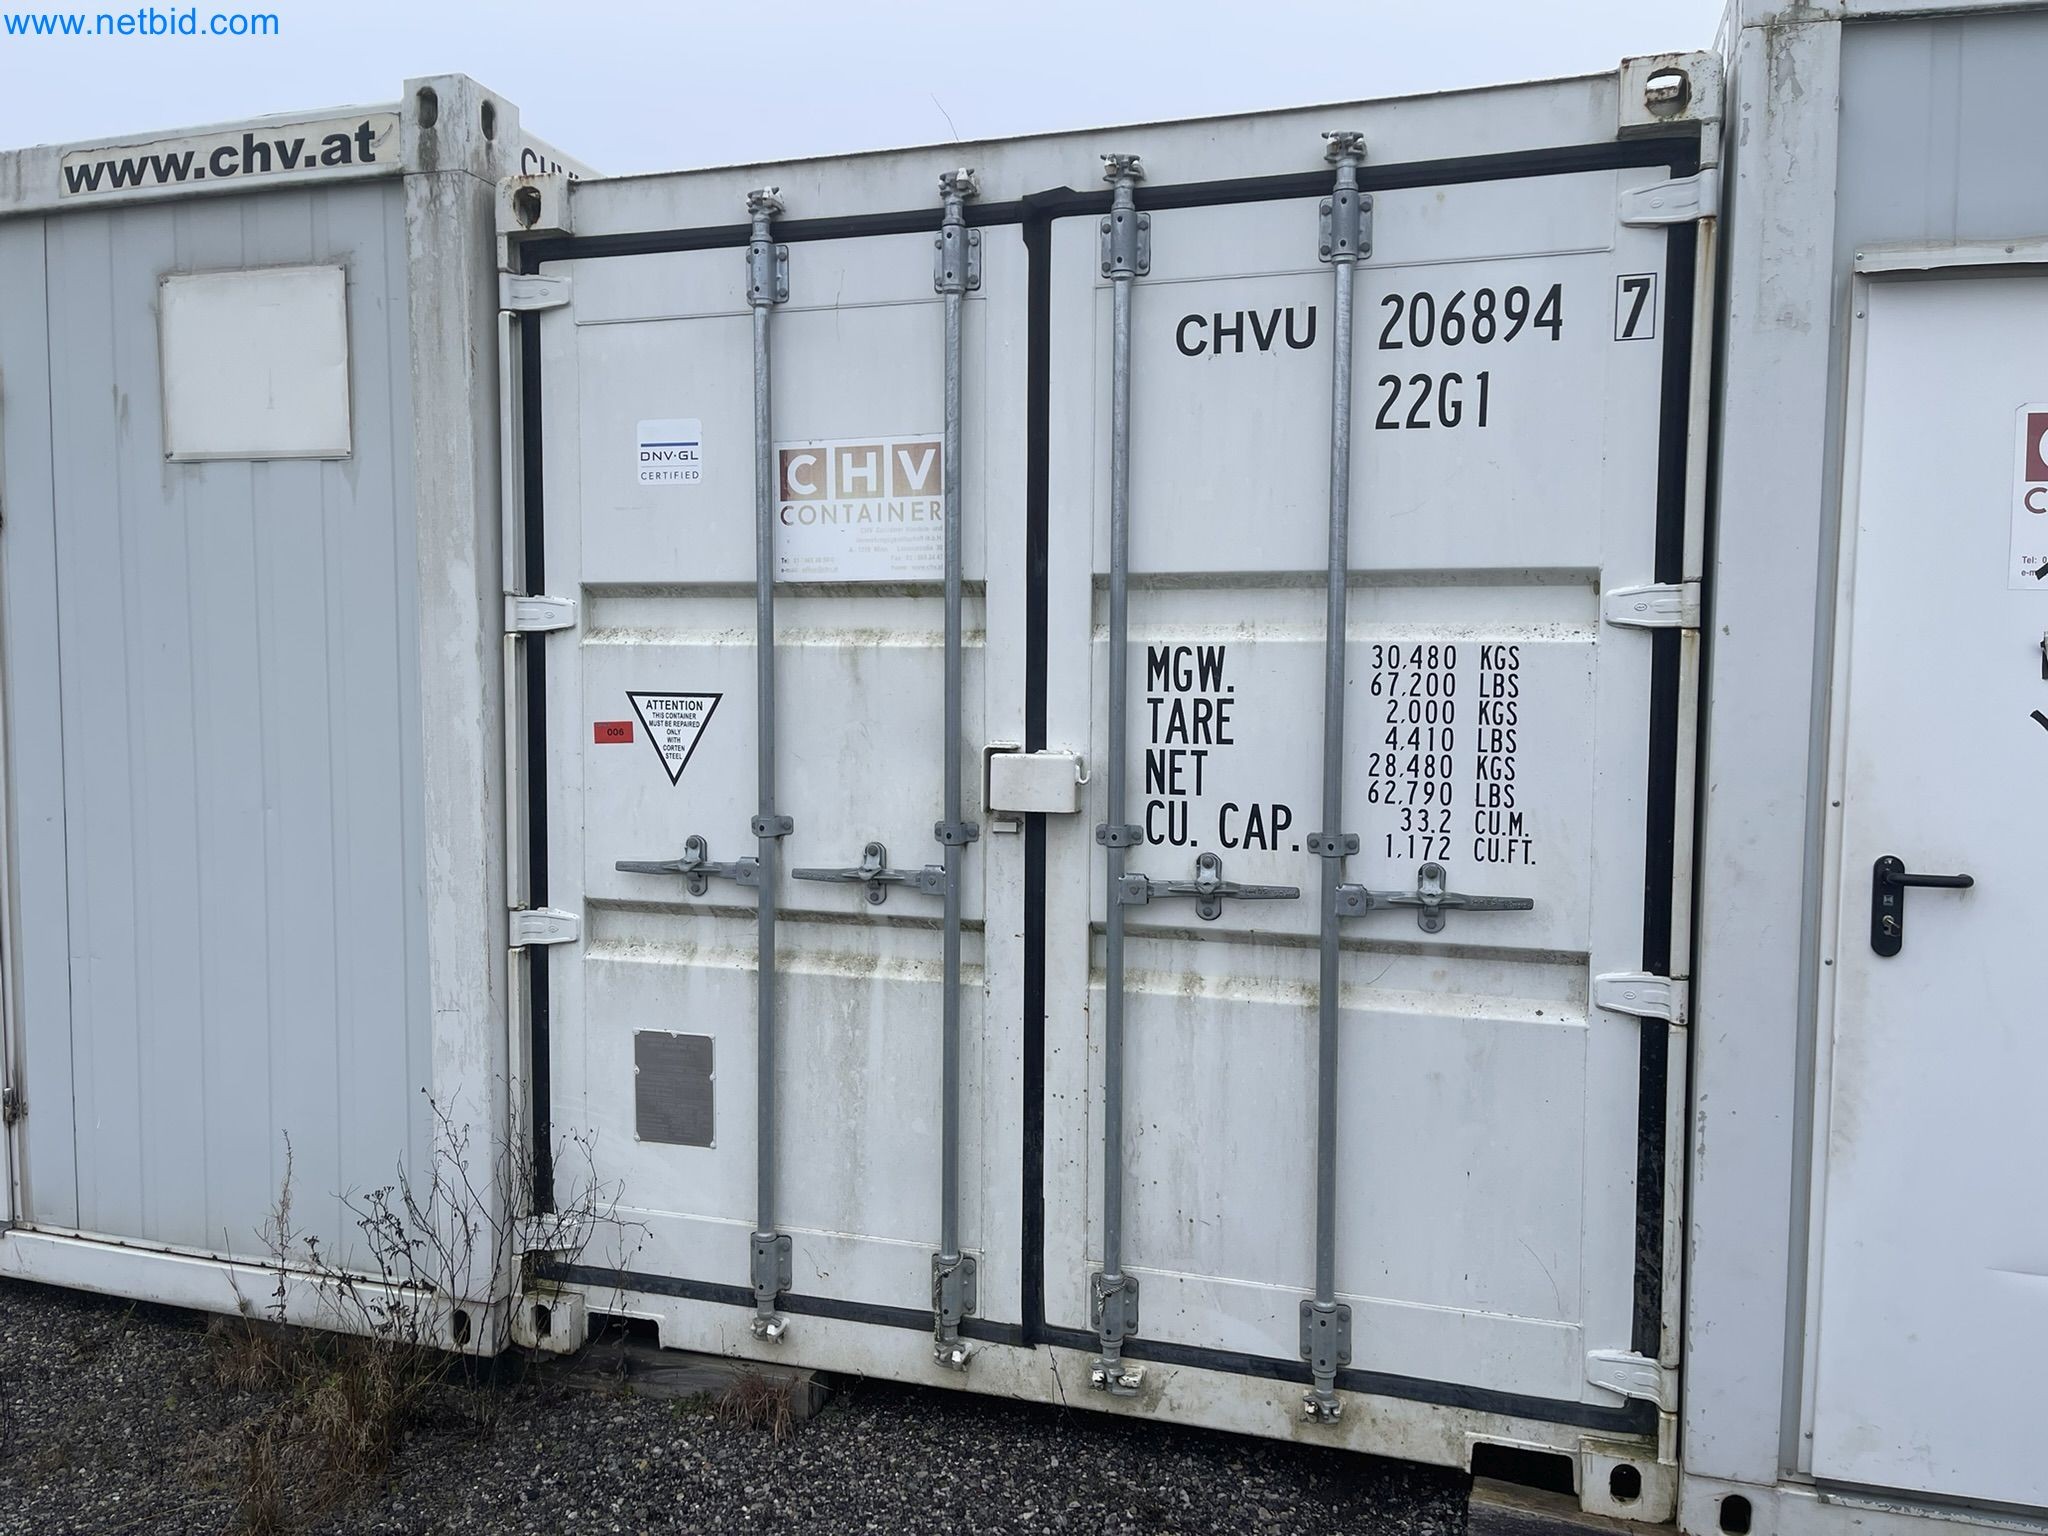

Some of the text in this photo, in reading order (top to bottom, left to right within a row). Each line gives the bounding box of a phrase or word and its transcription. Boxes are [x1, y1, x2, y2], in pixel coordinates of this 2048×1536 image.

[65, 121, 376, 194] www.chv.at
[1176, 278, 1650, 356] CHVU 206894 7
[1375, 371, 1489, 430] 22G1
[640, 470, 700, 481] CERTIFIED
[784, 446, 938, 497] CHV
[780, 500, 943, 527] CONTAINER
[2022, 556, 2037, 564] Tel:
[1147, 645, 1235, 693] MGW.
[1480, 645, 1520, 671] KGS
[1479, 673, 1519, 699] LBS
[645, 700, 703, 711] ATTENTION
[665, 712, 697, 720] CONTAINER
[1478, 701, 1518, 726] KGS
[606, 728, 625, 737] 006
[664, 720, 672, 728] BE
[673, 720, 701, 729] REPAIRED
[666, 728, 681, 736] ONLY
[1147, 698, 1235, 745] TARE
[662, 744, 686, 752] CORTEN
[1477, 728, 1517, 754] LBS
[665, 752, 682, 760] STEEL
[1476, 756, 1516, 781] KGS
[1145, 749, 1208, 796] NET
[1475, 783, 1515, 809] LBS
[1146, 800, 1300, 852] CU. CAP.
[1400, 808, 1530, 837] 33.2 CU.M.
[1474, 838, 1536, 865] CU.FT.
